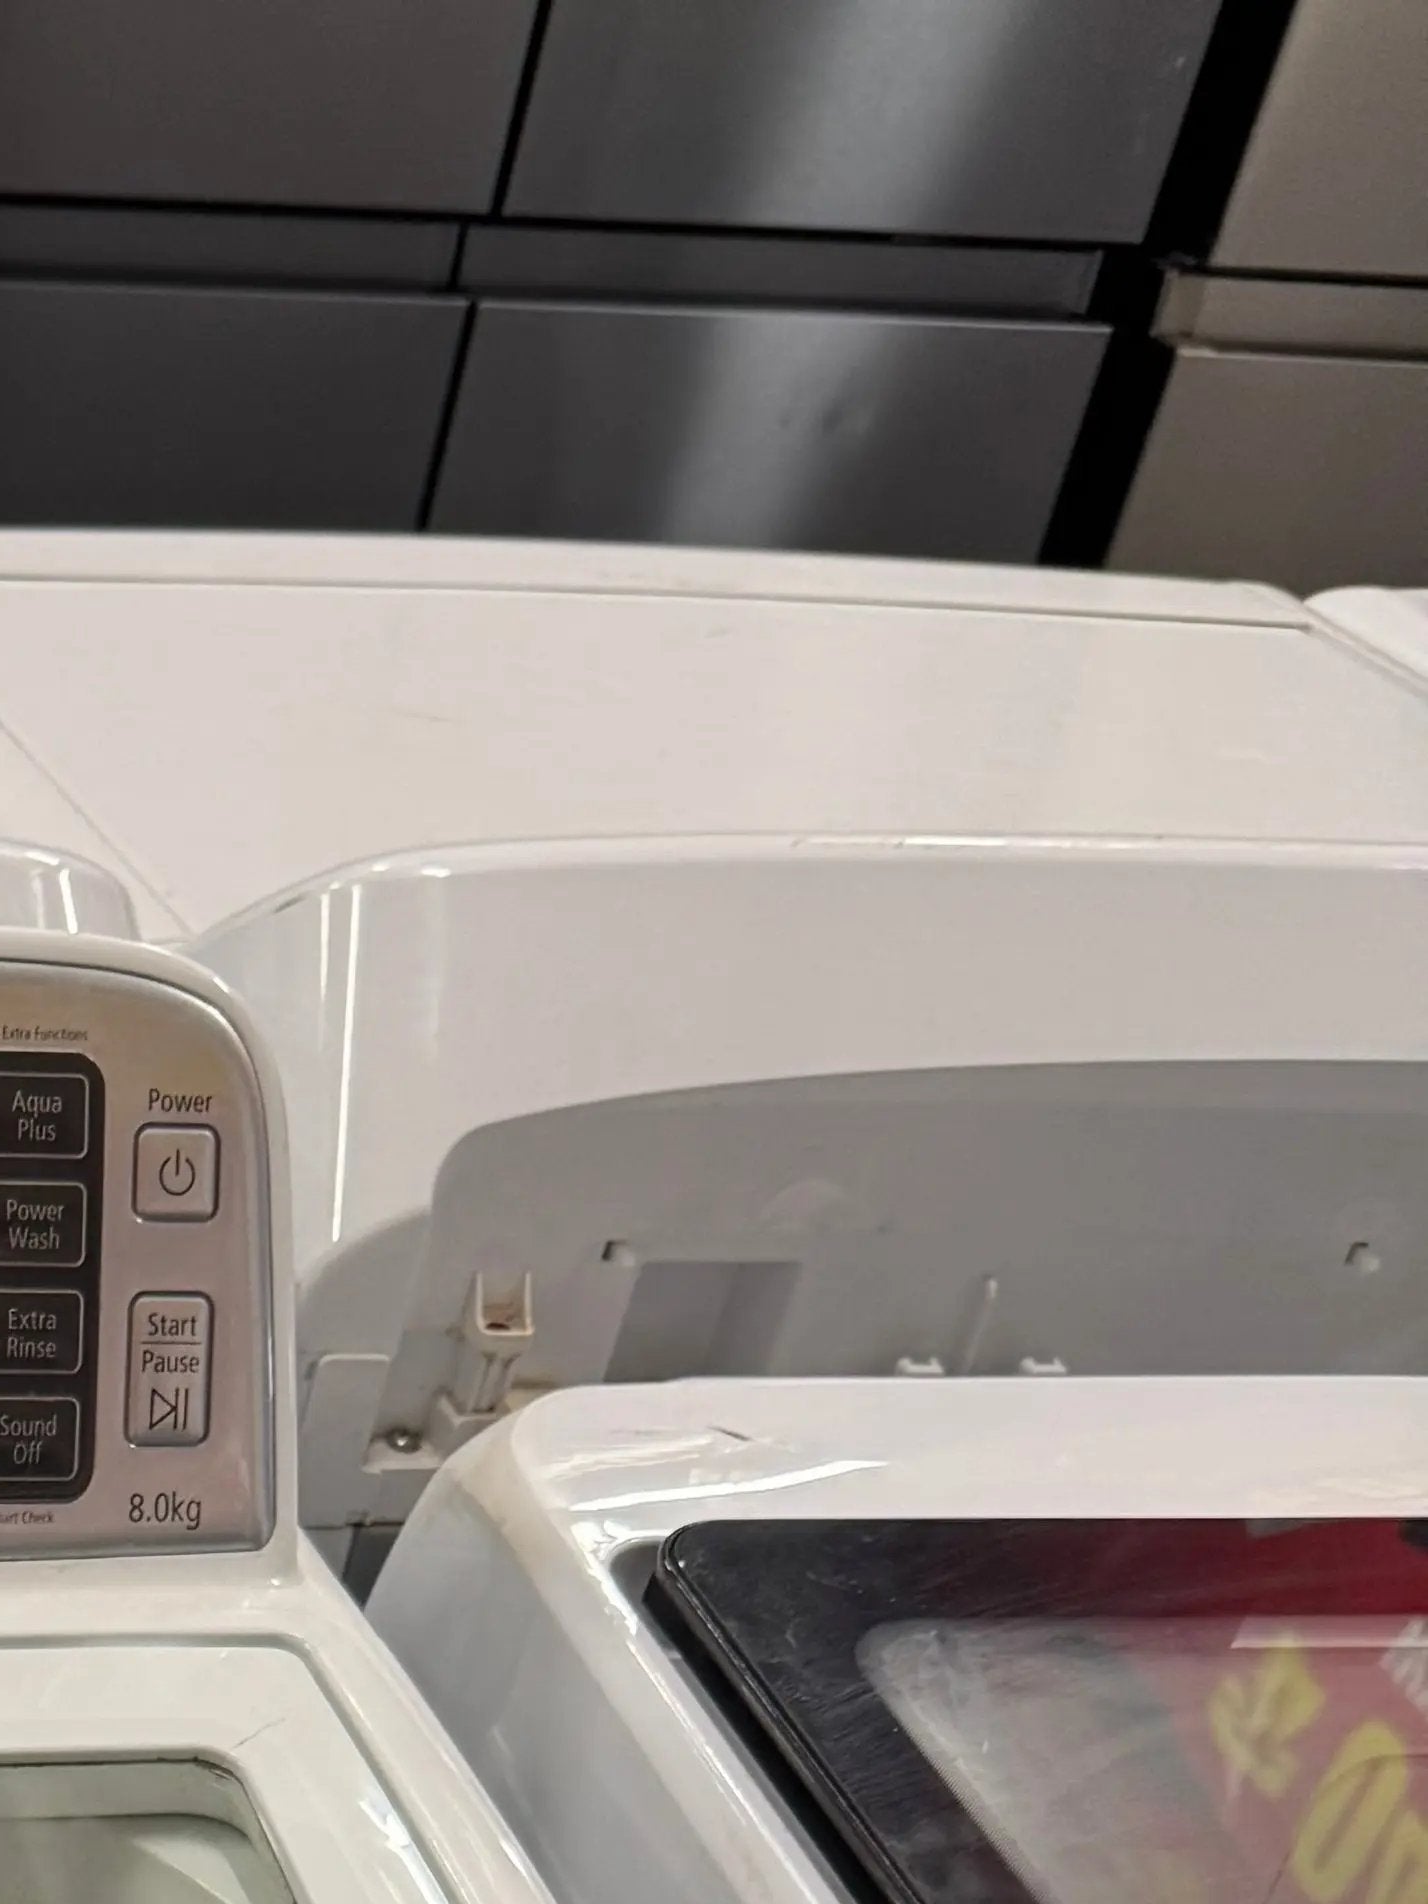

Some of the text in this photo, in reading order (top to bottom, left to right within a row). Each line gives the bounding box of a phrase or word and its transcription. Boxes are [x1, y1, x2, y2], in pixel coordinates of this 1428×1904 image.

[11, 1089, 62, 1118] Aqua
[148, 1087, 213, 1114] Power
[17, 1117, 56, 1141] Plus
[6, 1198, 65, 1222] Power
[8, 1226, 60, 1250] Wash
[8, 1307, 57, 1330] Extra
[147, 1312, 197, 1337] Start
[6, 1336, 57, 1358] Rinse
[141, 1349, 200, 1374] Pause
[0, 1414, 57, 1437] Sound
[13, 1440, 43, 1465] Off
[128, 1490, 202, 1531] 8.0kg
